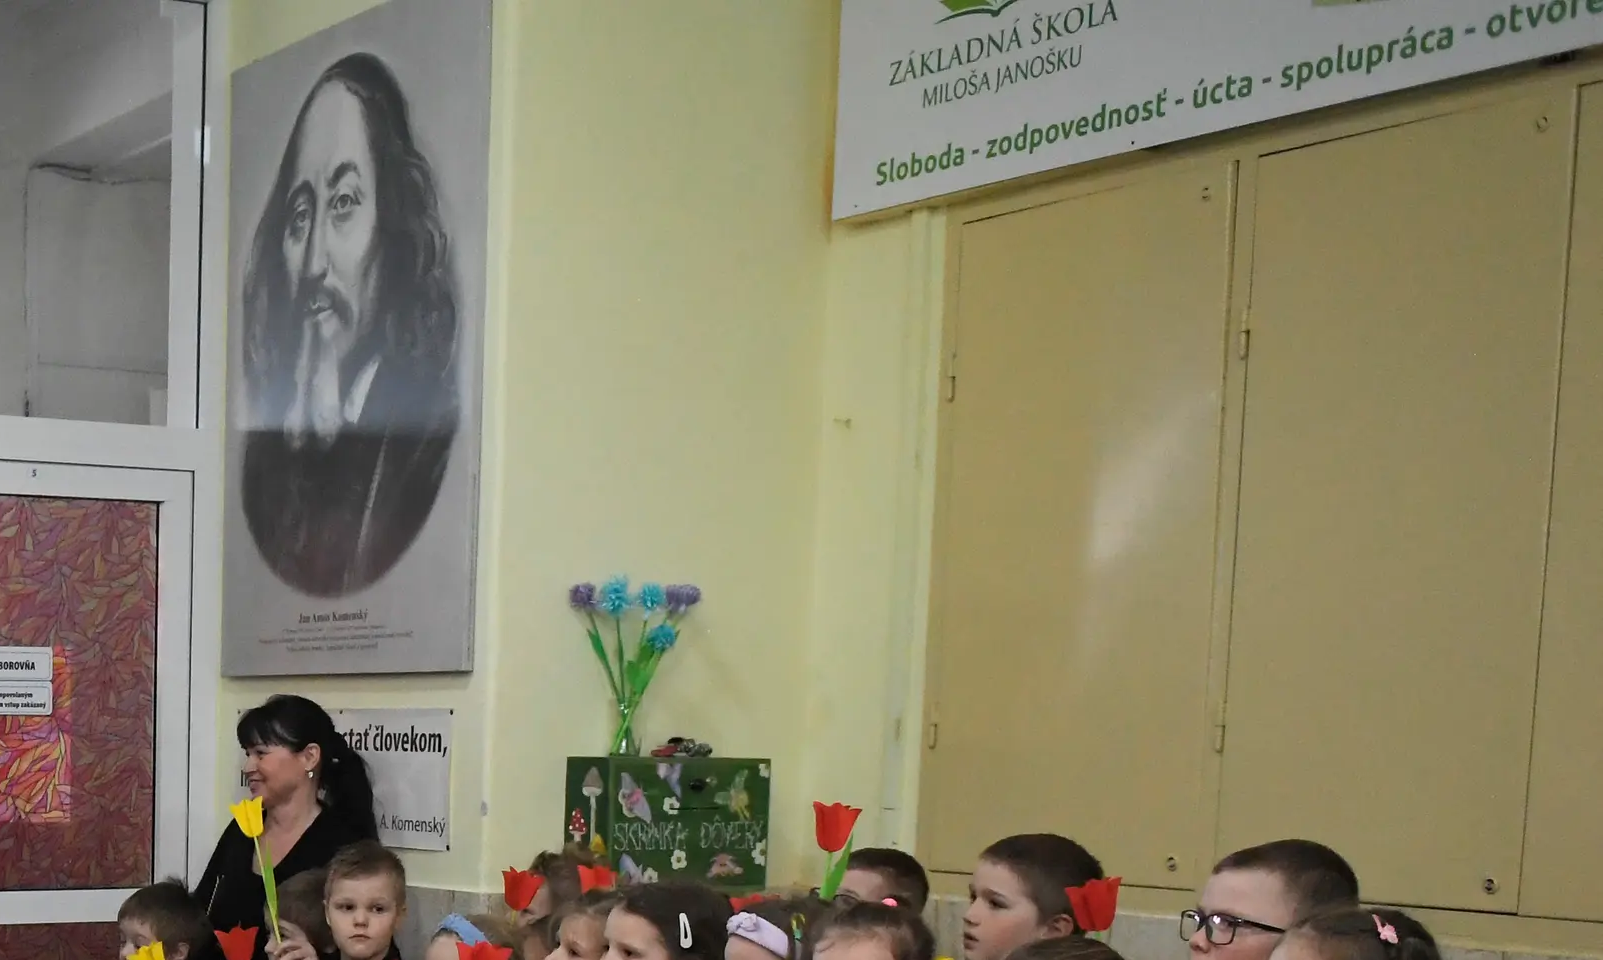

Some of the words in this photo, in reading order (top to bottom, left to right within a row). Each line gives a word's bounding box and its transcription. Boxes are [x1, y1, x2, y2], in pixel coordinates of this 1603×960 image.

[888, 18, 1022, 86] ZÁKLADNÁ
[1030, 0, 1119, 45] ŠKOLA
[875, 143, 965, 186] Sloboda
[985, 87, 1168, 158] zodpovednosť
[1193, 79, 1253, 109] úcta
[1280, 26, 1455, 91] spolupráca
[921, 69, 991, 109] MILOŠA
[995, 44, 1084, 94] JANOŠKU
[373, 724, 448, 757] človekom,
[380, 813, 389, 830] A.
[391, 814, 446, 838] Komenský
